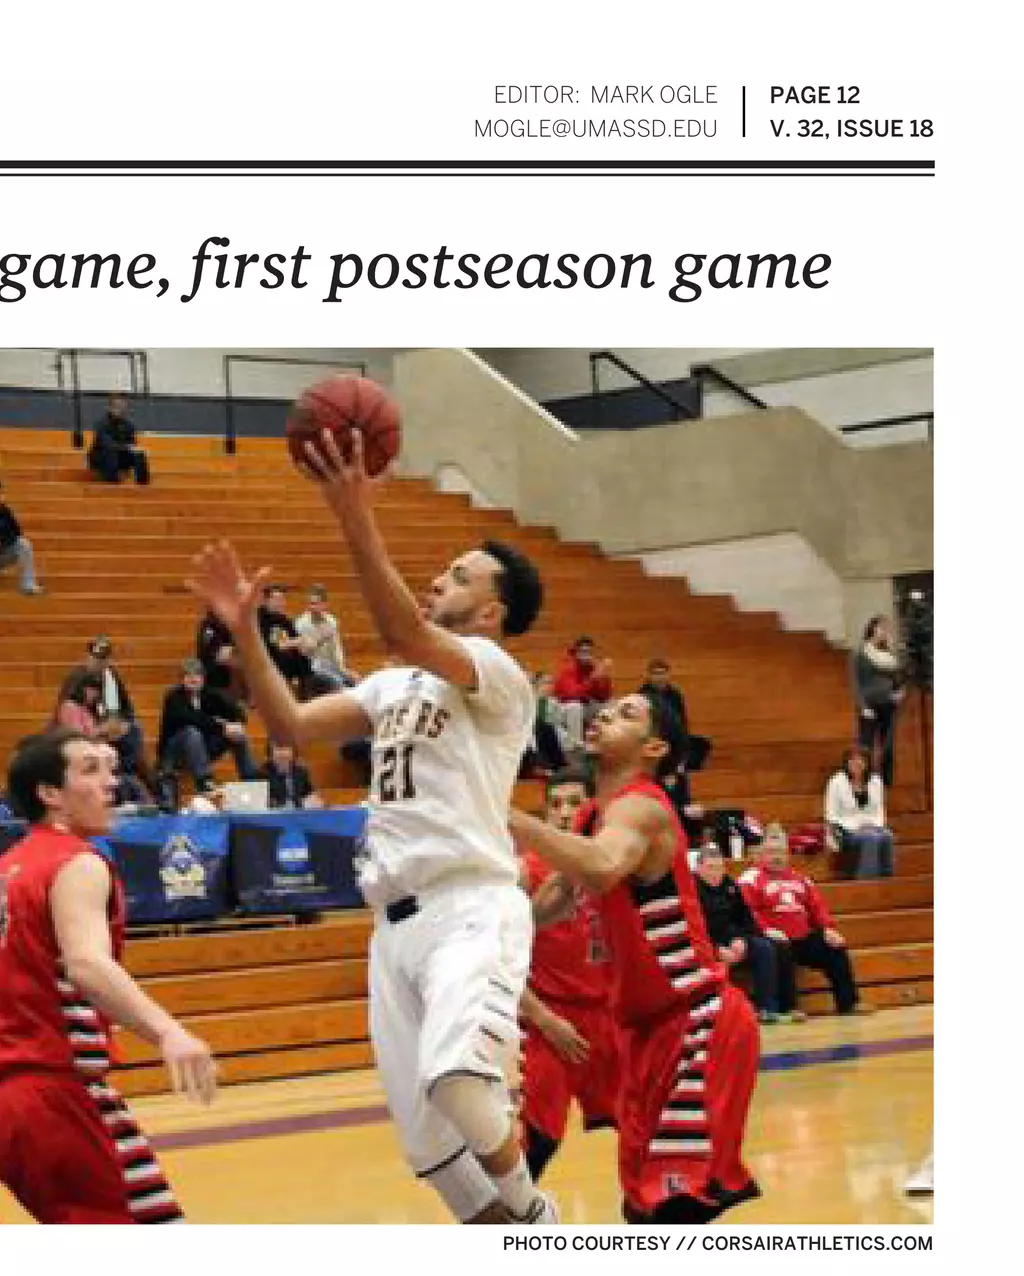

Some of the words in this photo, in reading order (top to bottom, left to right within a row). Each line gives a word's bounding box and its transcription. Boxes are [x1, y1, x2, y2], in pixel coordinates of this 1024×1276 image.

[496, 86, 578, 103] EDITOR:
[592, 86, 654, 103] MARK
[660, 85, 717, 103] OGLE
[771, 86, 830, 104] PAGE
[838, 86, 860, 103] 12
[476, 119, 716, 137] MOGLE@UMASSD.EDU
[770, 120, 790, 137] V.
[798, 119, 829, 139] 32,
[838, 119, 903, 137] ISSUE
[910, 119, 933, 137] 18
[181, 237, 311, 303] first
[322, 246, 655, 302] postseason
[669, 254, 831, 303] game
[380, 744, 416, 802] 21
[504, 1236, 567, 1250] PHOTO
[573, 1236, 670, 1250] COURTESY
[676, 1236, 696, 1250] //
[703, 1236, 932, 1250] CORSAIRATHLETICS.COM
